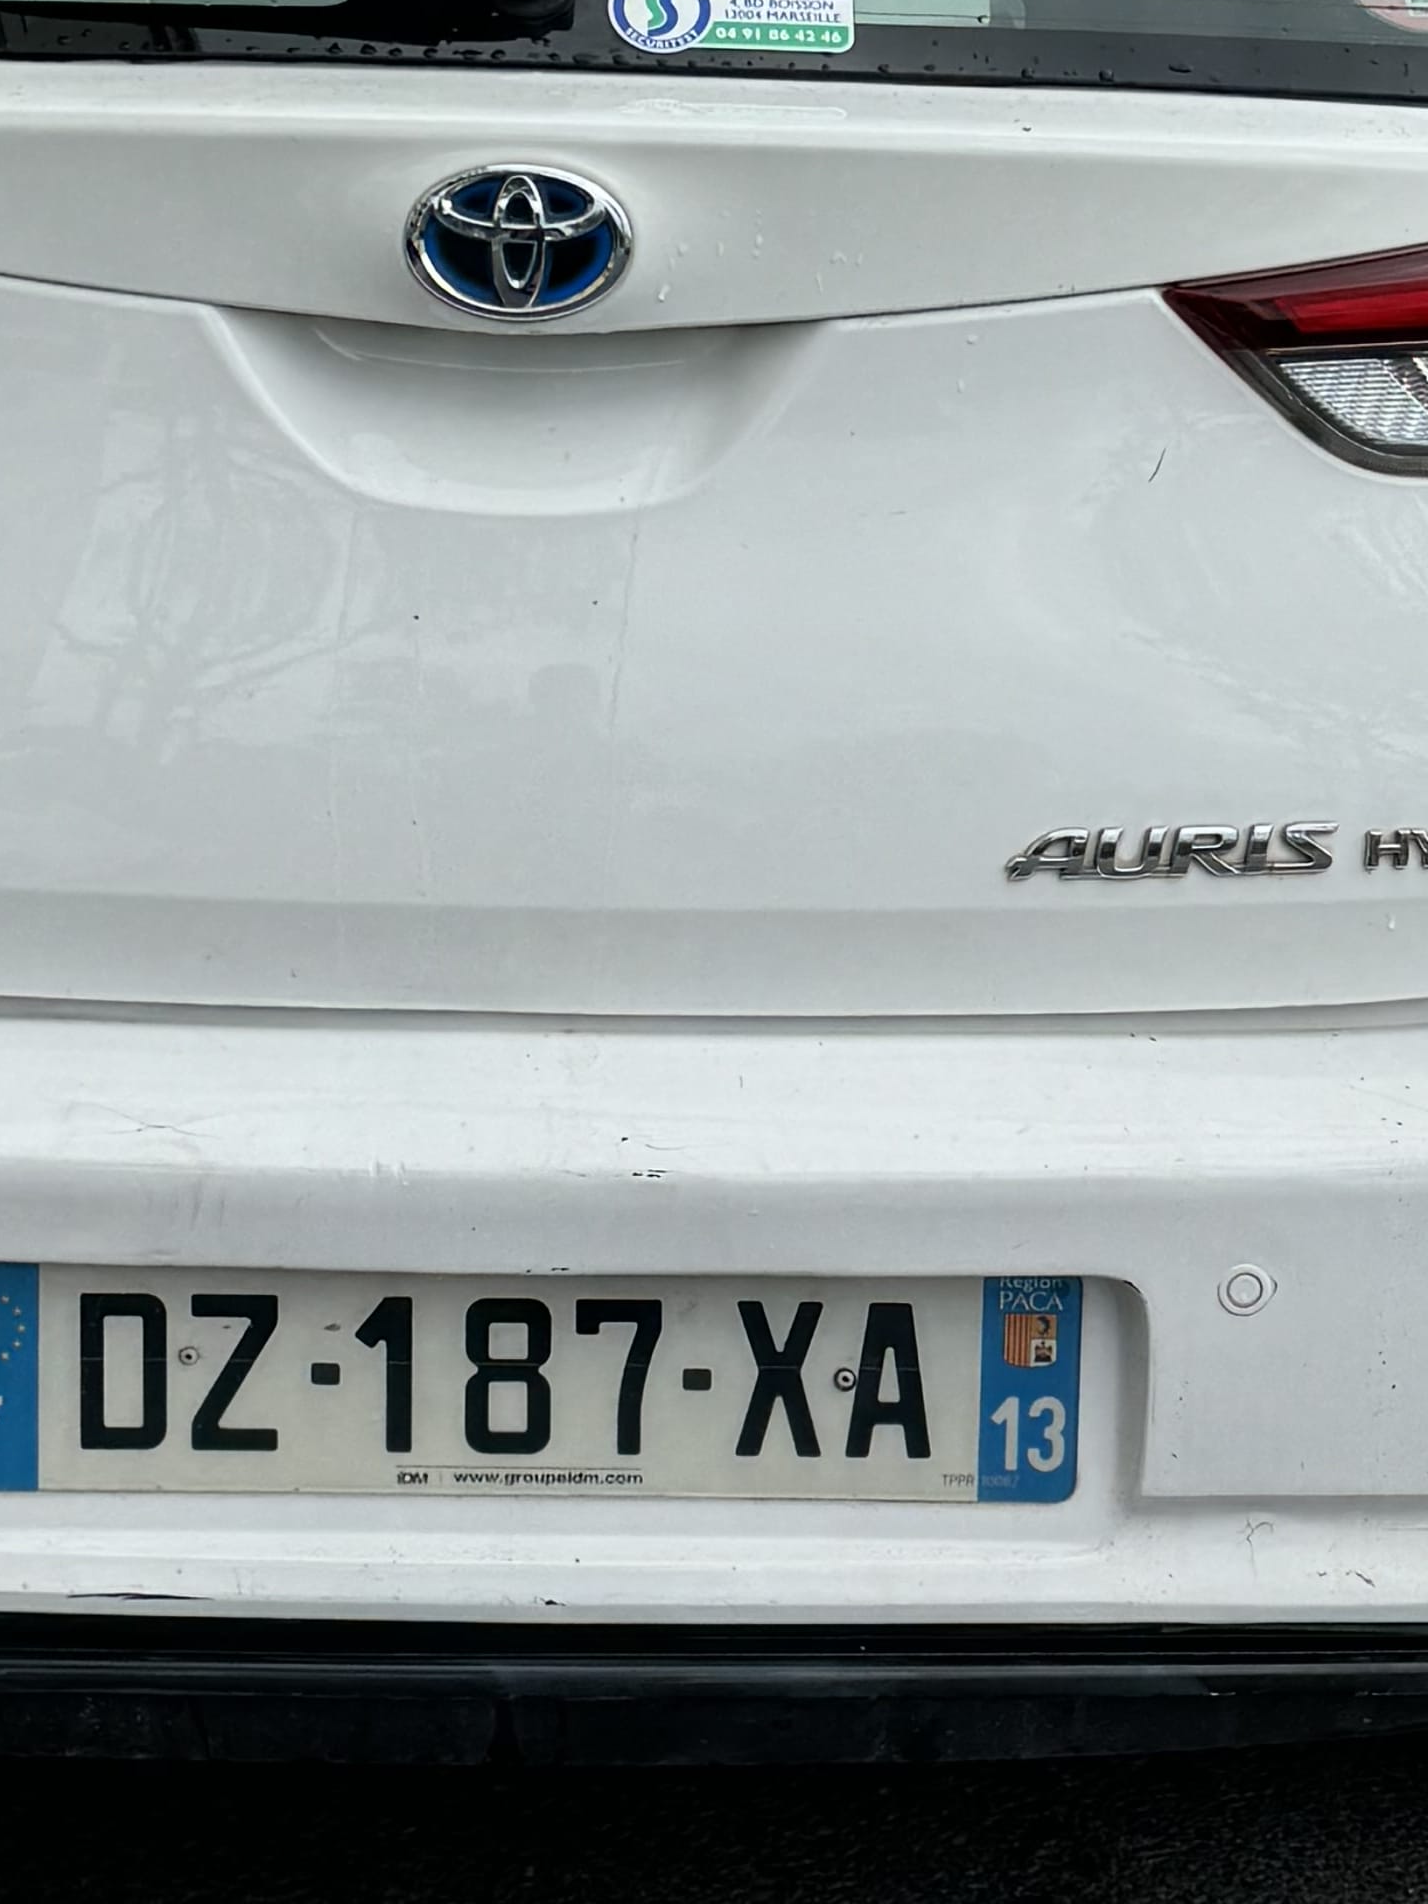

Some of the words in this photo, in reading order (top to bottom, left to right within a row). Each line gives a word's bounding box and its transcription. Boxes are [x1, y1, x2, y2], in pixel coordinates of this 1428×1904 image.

[715, 27, 737, 39] 04
[741, 27, 761, 40] 91
[767, 10, 841, 23] MARSEILLE
[1004, 820, 1340, 881] AURIS
[999, 1290, 1064, 1312] PACA
[79, 1292, 932, 1459] DZ-187-XA
[990, 1395, 1067, 1473] 13
